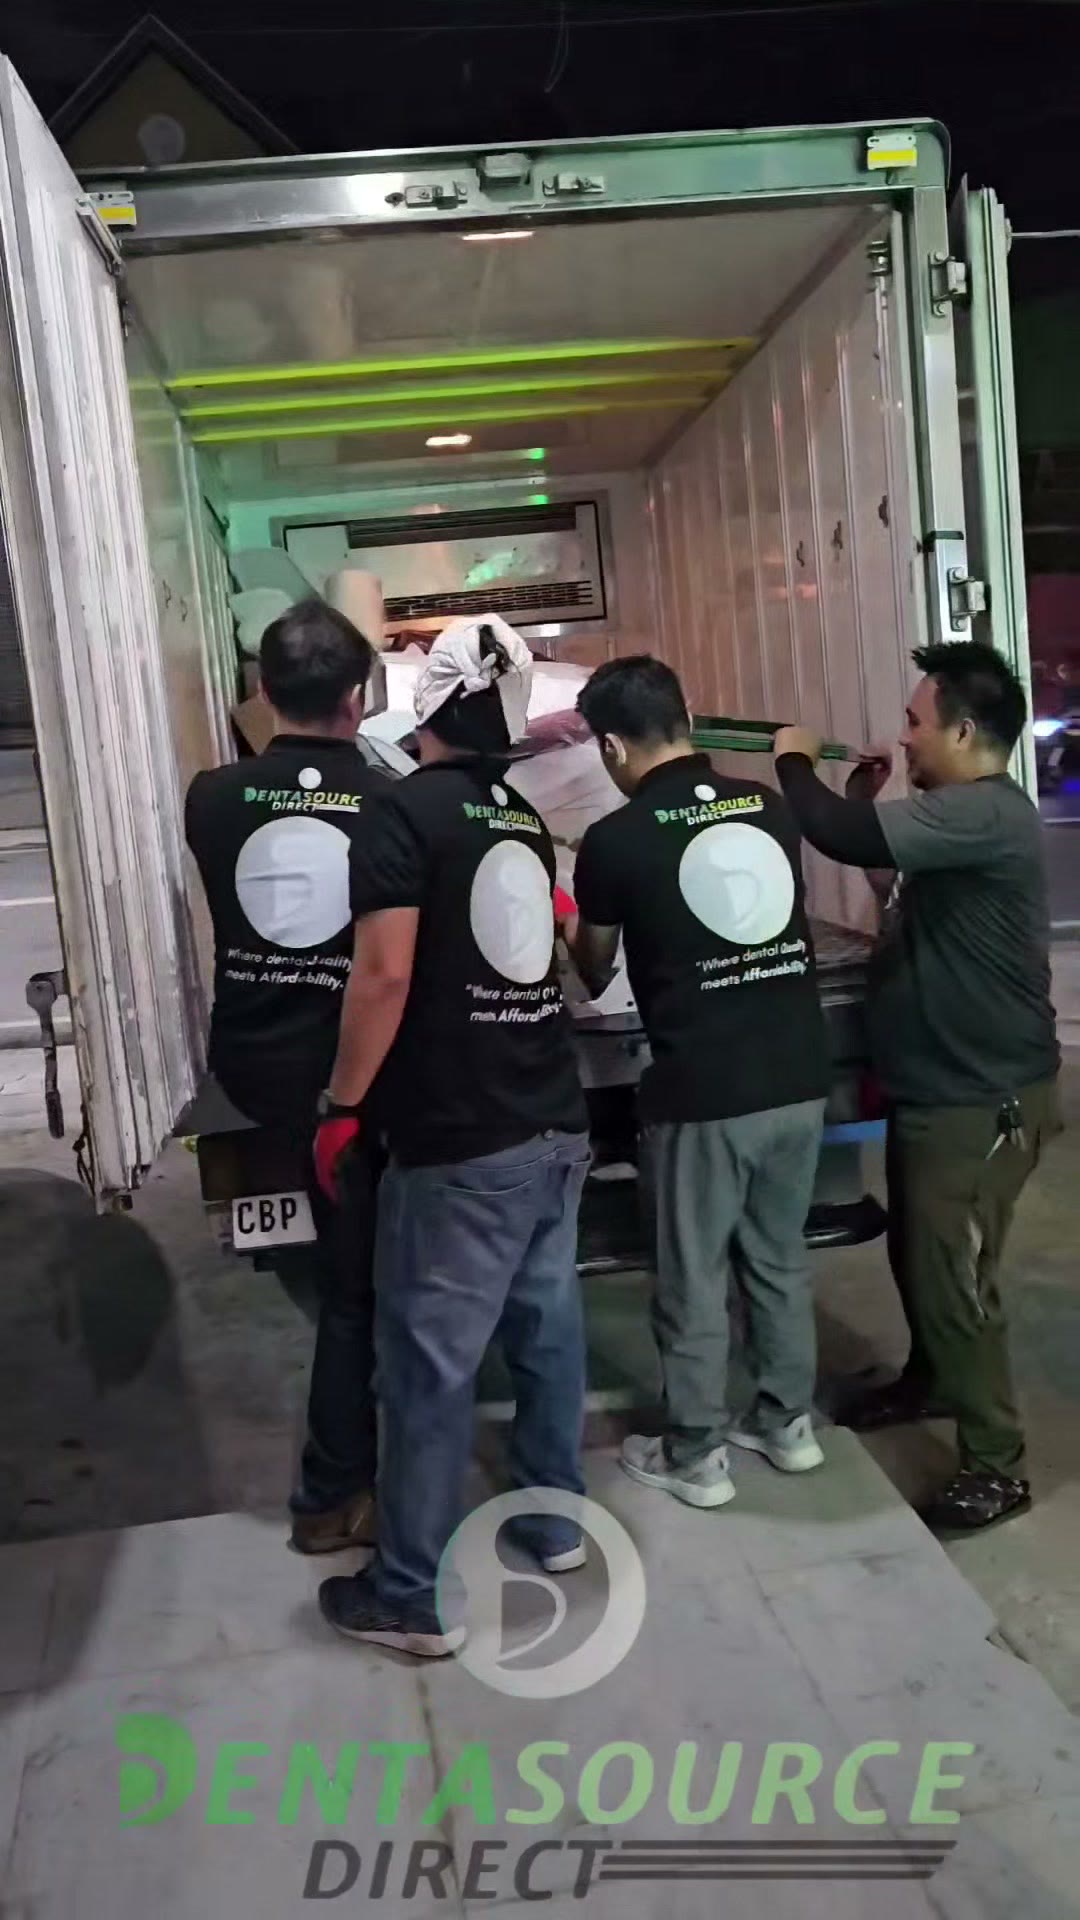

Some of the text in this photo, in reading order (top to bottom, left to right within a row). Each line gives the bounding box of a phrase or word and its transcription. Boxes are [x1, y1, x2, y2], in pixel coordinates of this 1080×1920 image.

[244, 787, 362, 806] DENTASOURC
[272, 801, 318, 812] DIRECT
[654, 794, 764, 824] DENTASOURCE
[686, 811, 729, 826] DIRECT
[266, 953, 306, 967] dental
[742, 947, 779, 962] dental
[701, 975, 740, 991] meets
[503, 987, 541, 1001] dental
[237, 1197, 297, 1235] CBP
